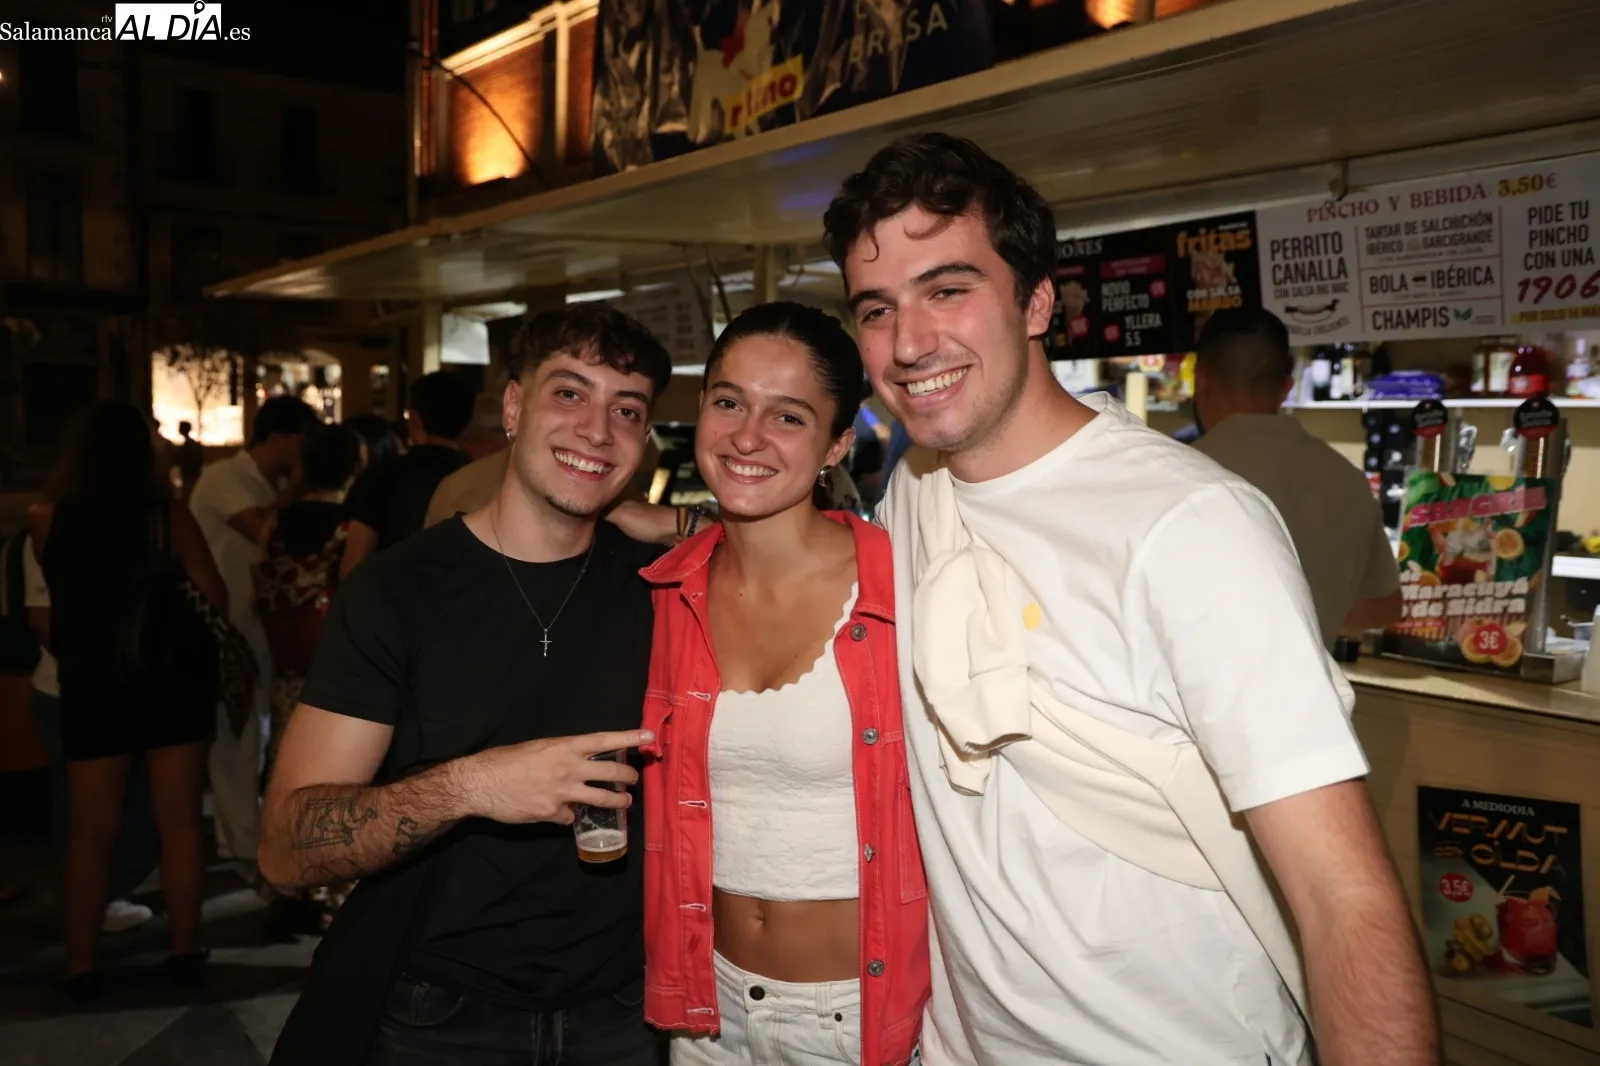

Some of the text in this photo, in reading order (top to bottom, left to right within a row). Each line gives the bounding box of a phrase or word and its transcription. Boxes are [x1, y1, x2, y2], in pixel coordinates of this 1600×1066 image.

[1307, 199, 1379, 223] PINCHO
[1389, 195, 1400, 212] Y
[1528, 200, 1589, 226] PIDE TU
[1404, 220, 1418, 236] DE
[1529, 224, 1589, 249] PINCHO
[1177, 226, 1252, 258] fritas
[1270, 231, 1343, 262] PERRITO
[1272, 256, 1348, 286] CANALLA
[1524, 246, 1595, 271] CON UNA
[1369, 273, 1408, 294] BOLA
[1431, 265, 1494, 289] IBÉRICA
[1517, 270, 1600, 305] 1906
[1372, 306, 1450, 331] CHAMPIS
[1447, 597, 1526, 617] Sidra
[1479, 630, 1500, 650] 3€
[1461, 798, 1471, 809] A
